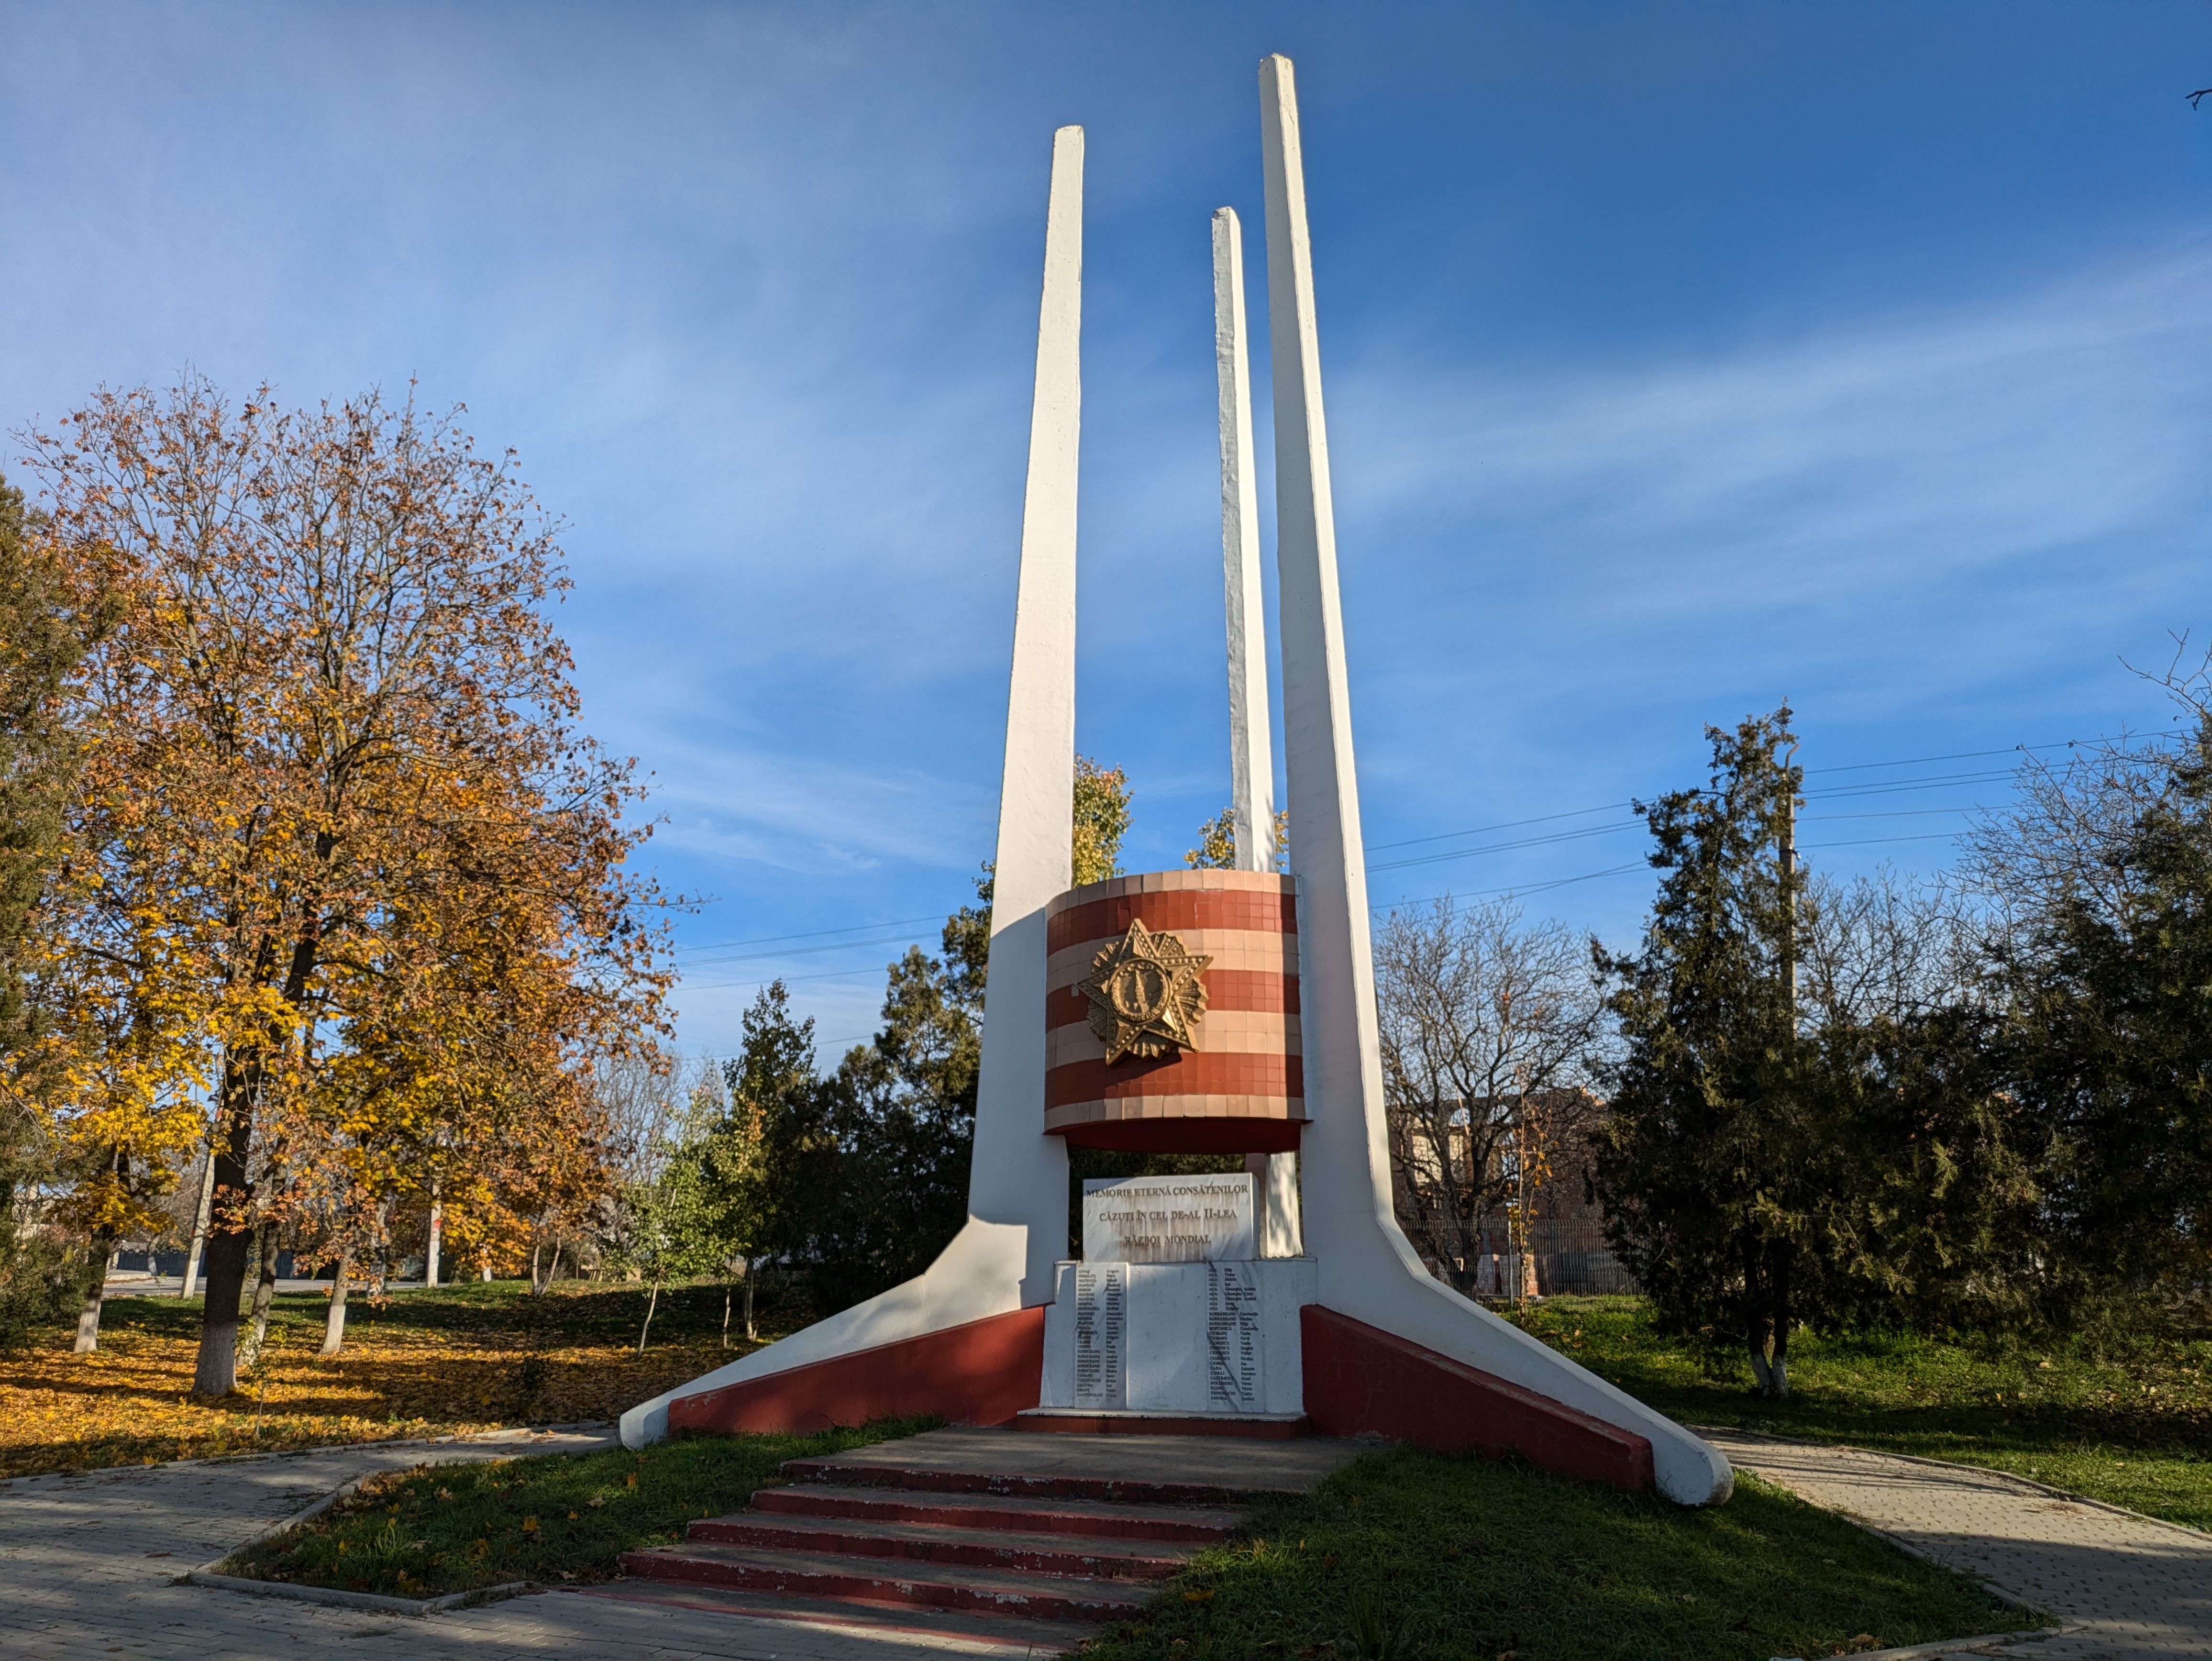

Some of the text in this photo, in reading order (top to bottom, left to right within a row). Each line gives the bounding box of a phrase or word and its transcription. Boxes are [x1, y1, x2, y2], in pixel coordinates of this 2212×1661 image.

[1086, 1183, 1248, 1197] MEMORIE ETERNĂ CONSĂTENILOR
[1099, 1208, 1237, 1222] CĂZUȚI ÎN CEL DE-AL II-LEA
[1124, 1235, 1211, 1244] RĂZBOI MONDIAL
